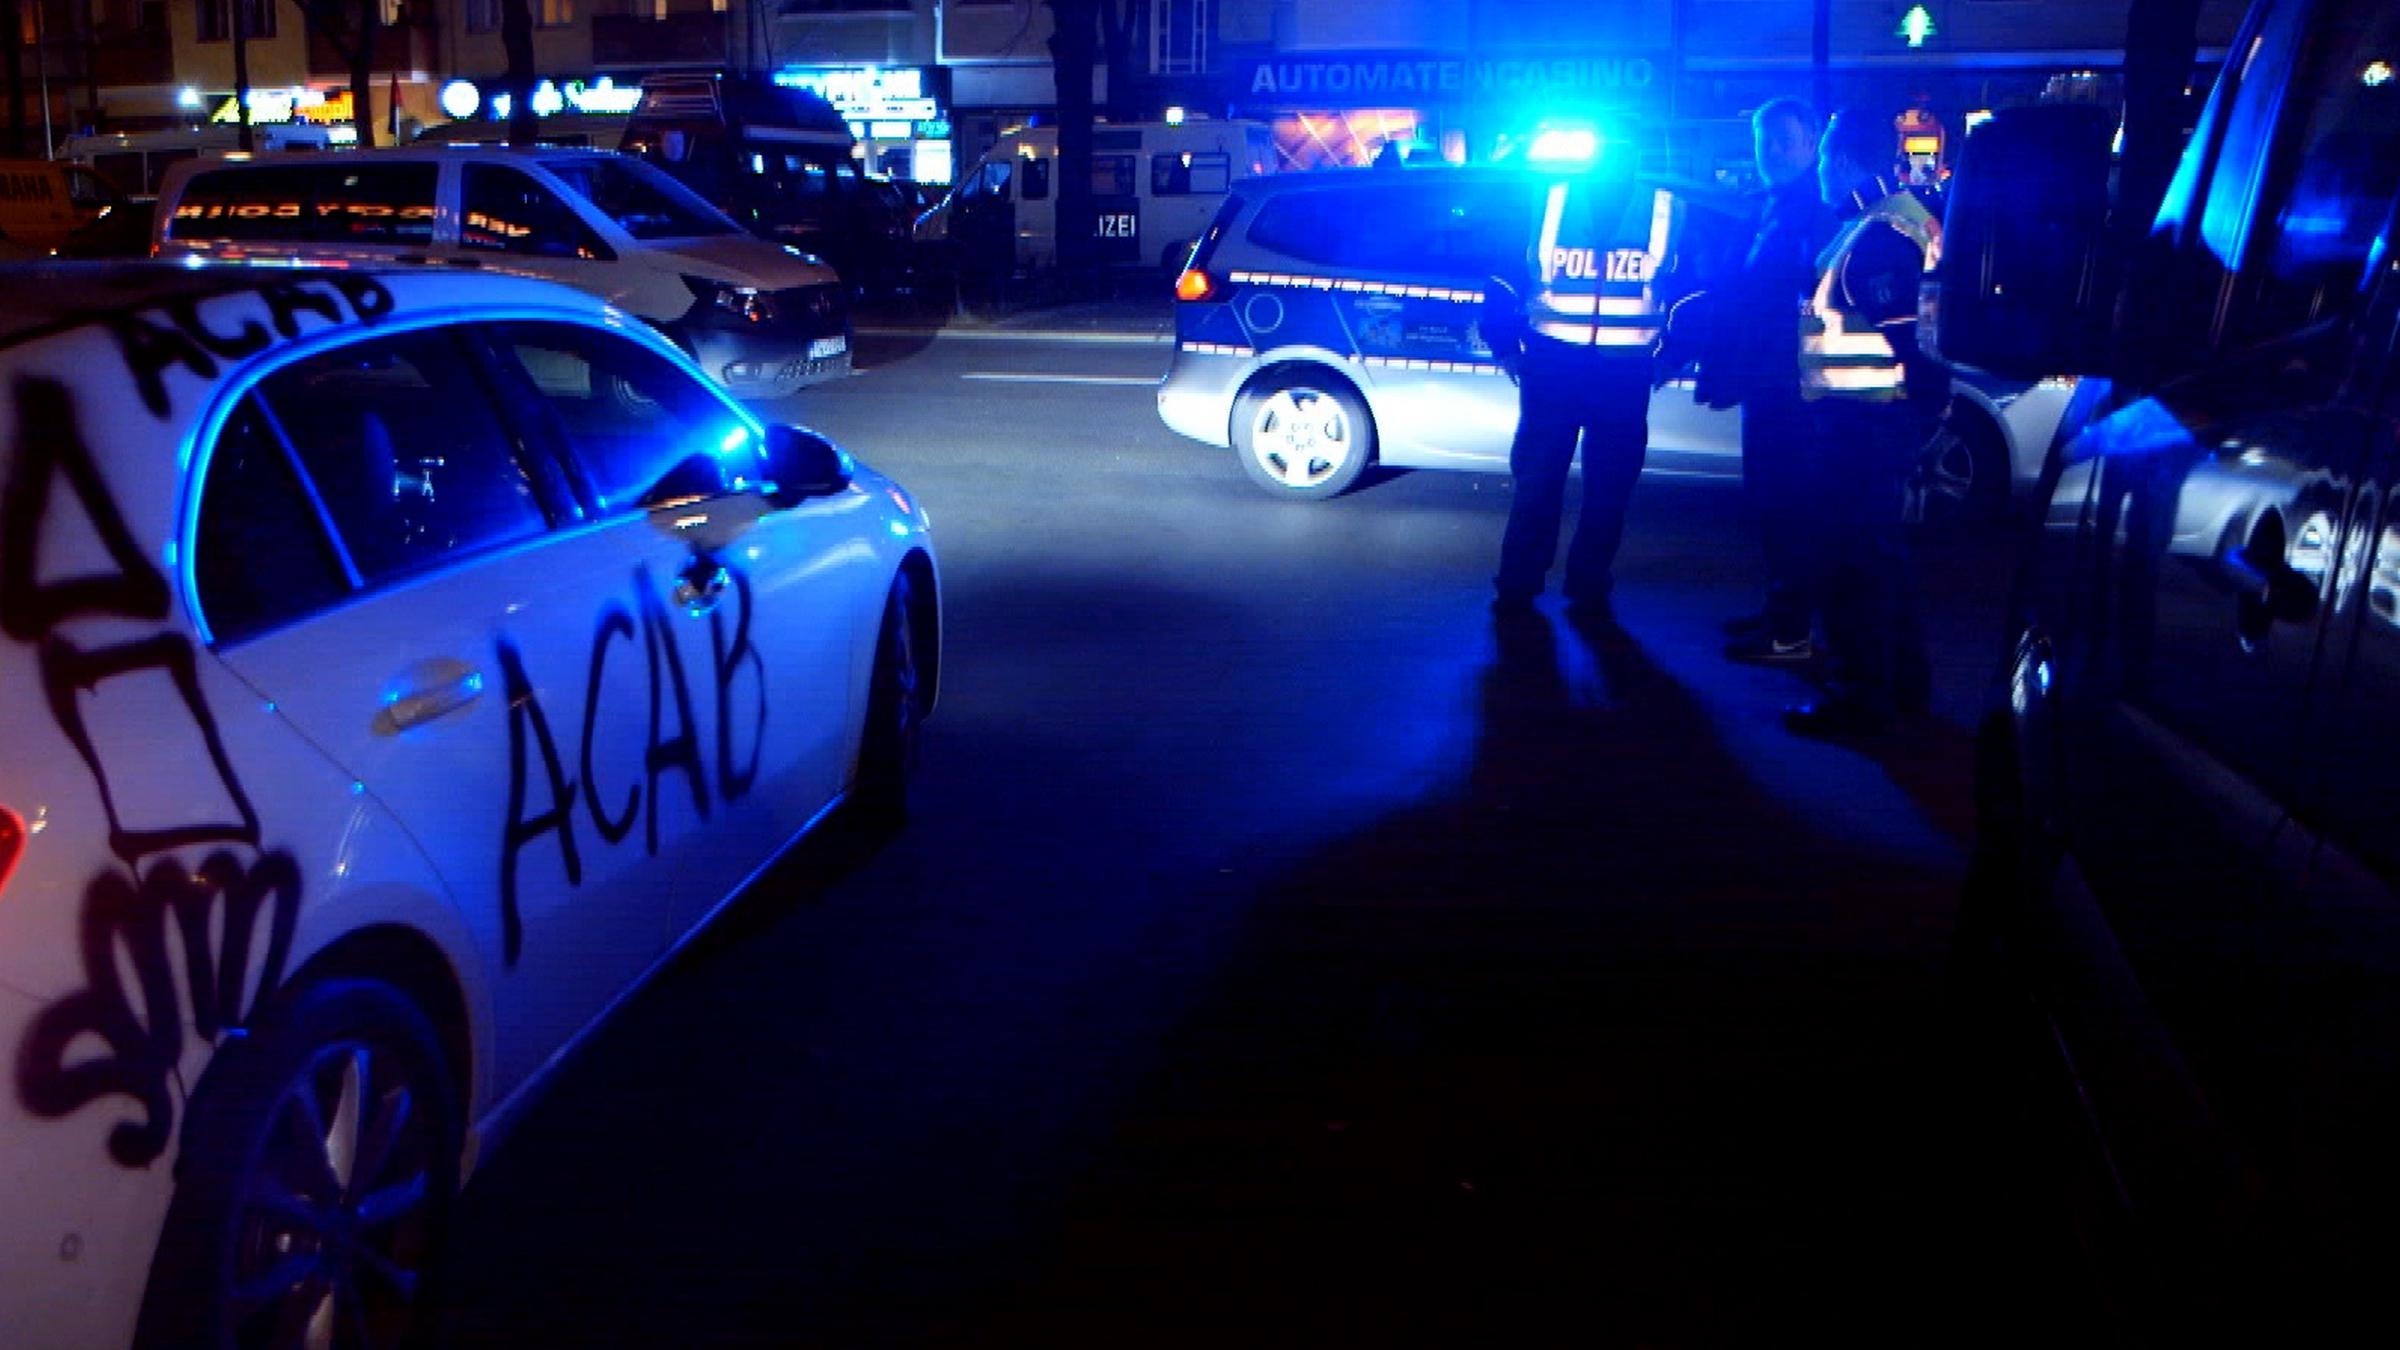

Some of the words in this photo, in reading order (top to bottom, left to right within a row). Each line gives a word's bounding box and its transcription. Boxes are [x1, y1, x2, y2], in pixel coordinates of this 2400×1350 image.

[1093, 213, 1136, 237] IZEI
[107, 274, 395, 421] ACAB
[497, 558, 767, 967] ACAB
